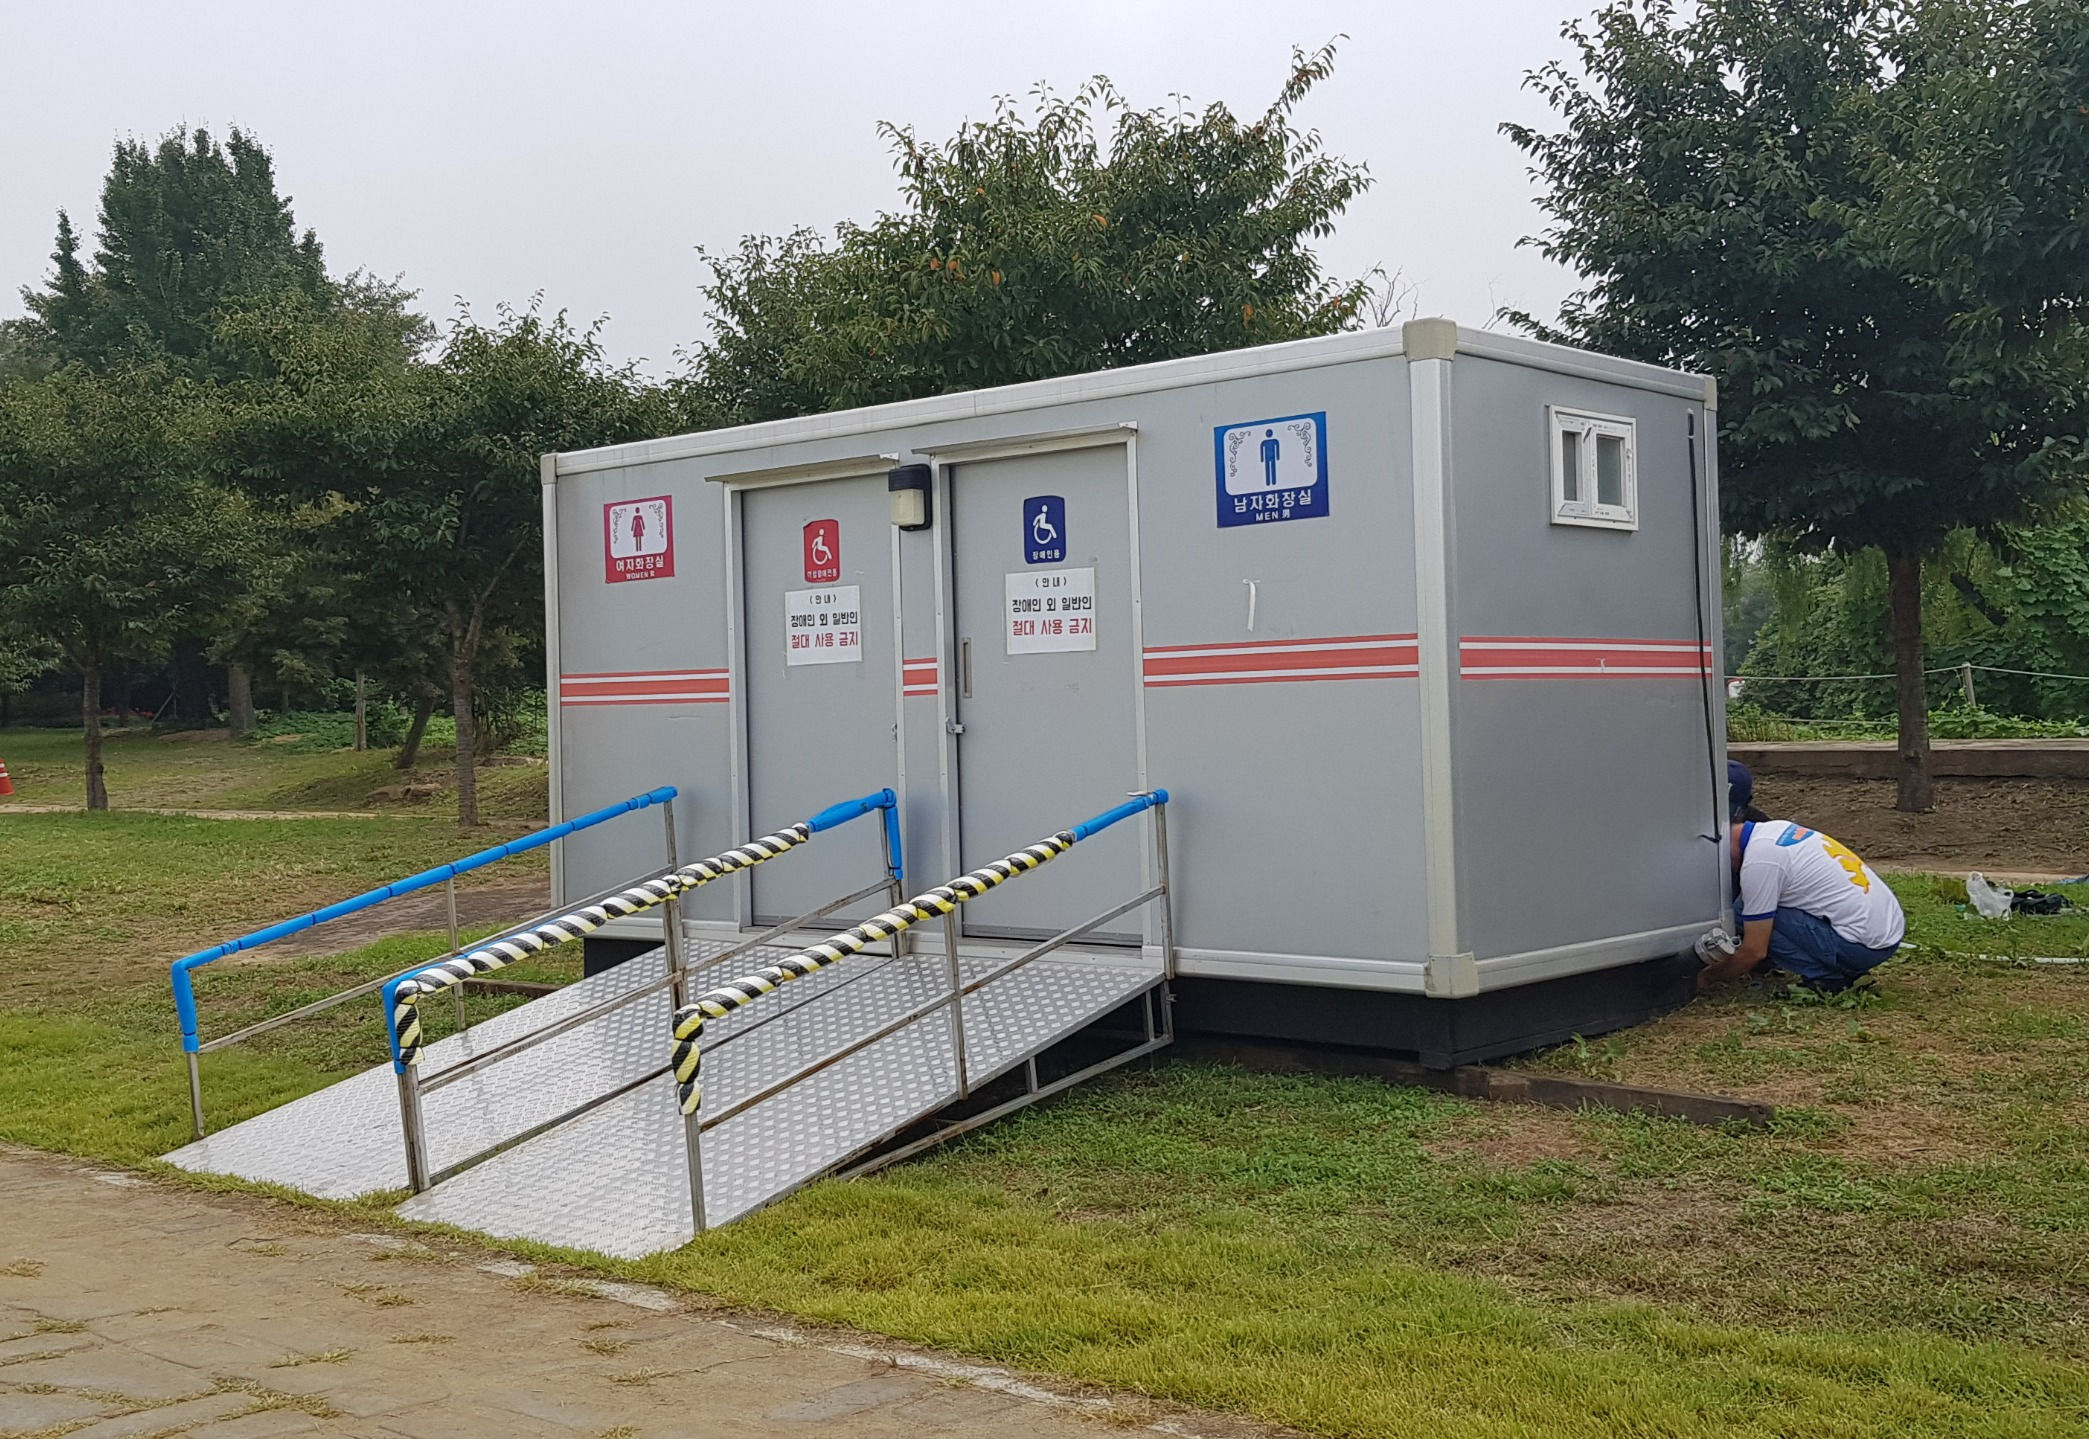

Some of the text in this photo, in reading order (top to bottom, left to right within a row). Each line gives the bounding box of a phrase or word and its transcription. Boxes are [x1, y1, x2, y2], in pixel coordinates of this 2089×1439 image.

[1234, 489, 1311, 513] 남자화장실
[1255, 511, 1278, 521] MEN
[1032, 549, 1060, 560] 장애인용
[616, 555, 664, 572] 여자화장실
[626, 571, 649, 579] WOMEN
[1012, 596, 1092, 613] 장애인 외 일반인
[790, 611, 858, 628] 장애인 외 일반인
[1012, 617, 1092, 636] 절대 사용 금지
[791, 631, 858, 649] 절대 사용 금지
